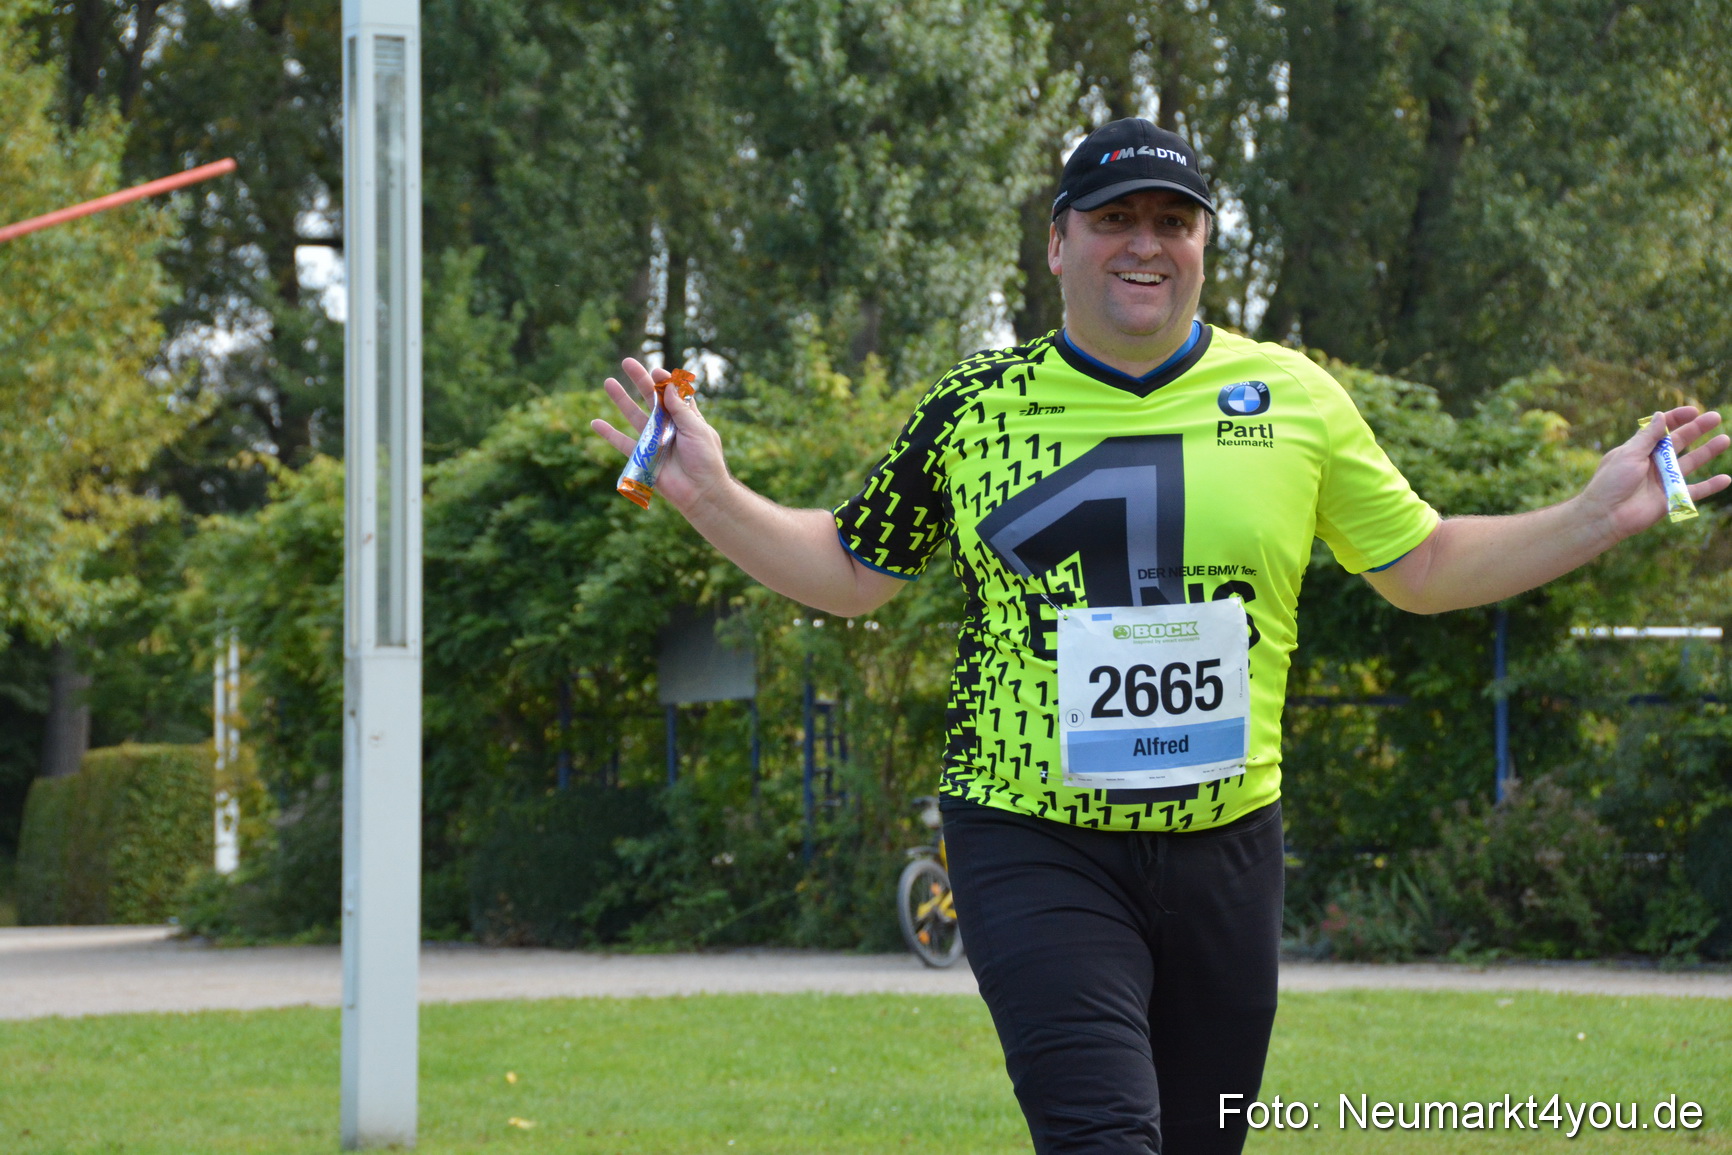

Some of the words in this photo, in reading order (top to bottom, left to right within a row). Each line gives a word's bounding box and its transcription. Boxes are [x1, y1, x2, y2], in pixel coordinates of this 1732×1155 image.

[1156, 147, 1187, 166] DTM
[1217, 420, 1274, 439] Partl
[1217, 439, 1274, 448] Neumarkt
[1138, 567, 1166, 580] DER
[1168, 565, 1206, 578] NEUE
[1207, 565, 1239, 576] BMW
[1132, 621, 1199, 639] BOCK
[1089, 658, 1223, 718] 2665
[1071, 713, 1078, 723] D
[1133, 734, 1189, 757] Alfred
